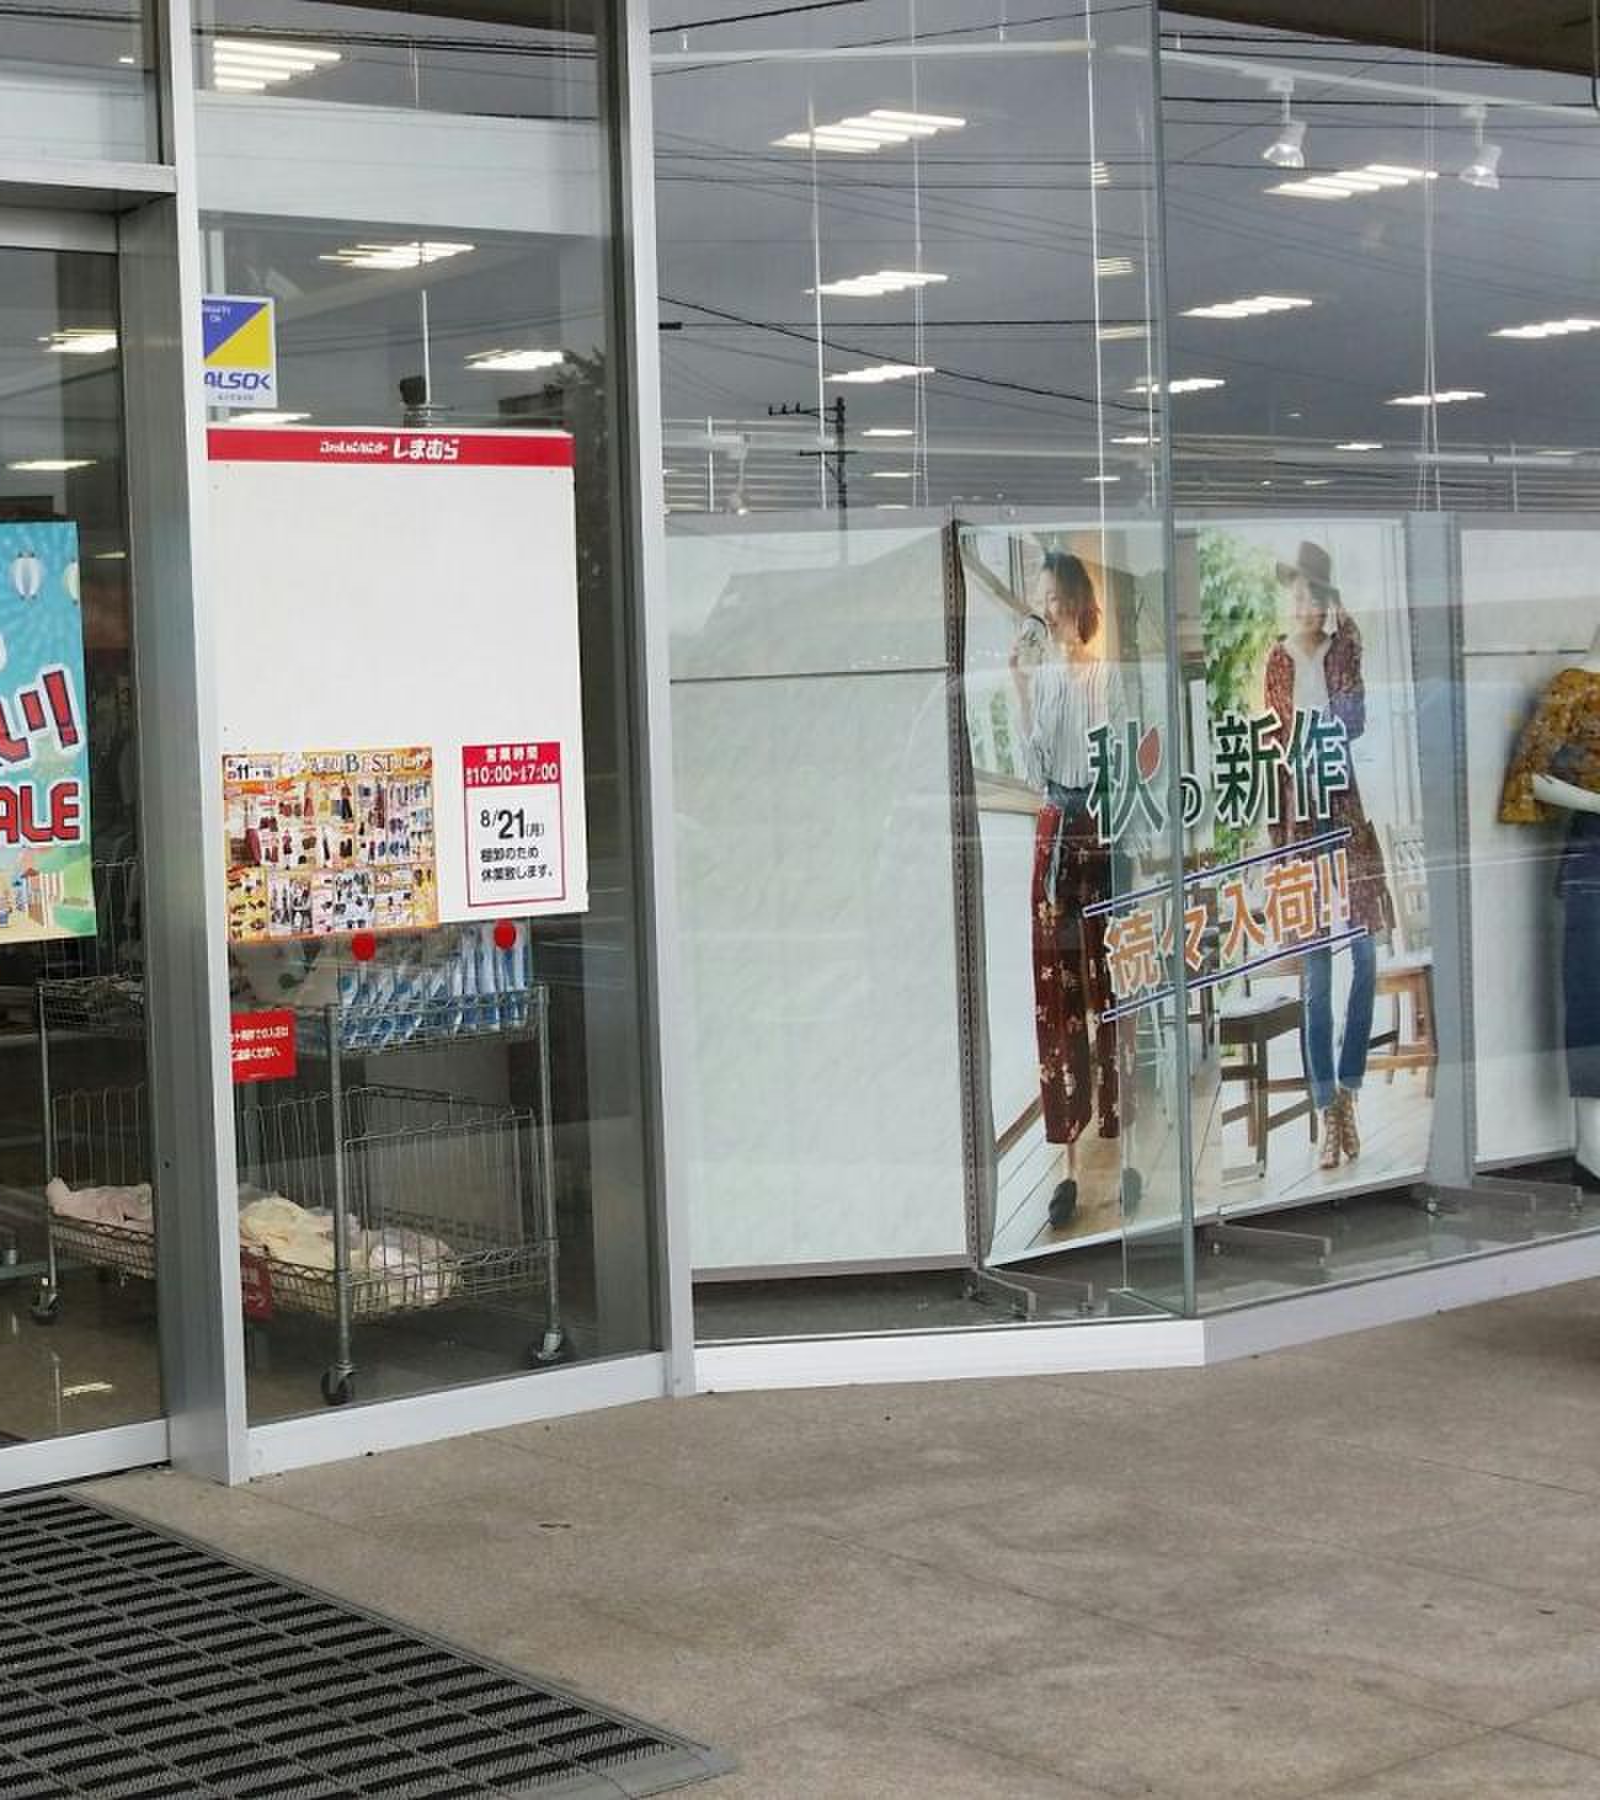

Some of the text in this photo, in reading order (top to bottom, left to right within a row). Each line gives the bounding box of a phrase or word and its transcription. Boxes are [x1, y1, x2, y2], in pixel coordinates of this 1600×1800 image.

[204, 371, 271, 390] ALSOK
[393, 437, 459, 460] しまむら
